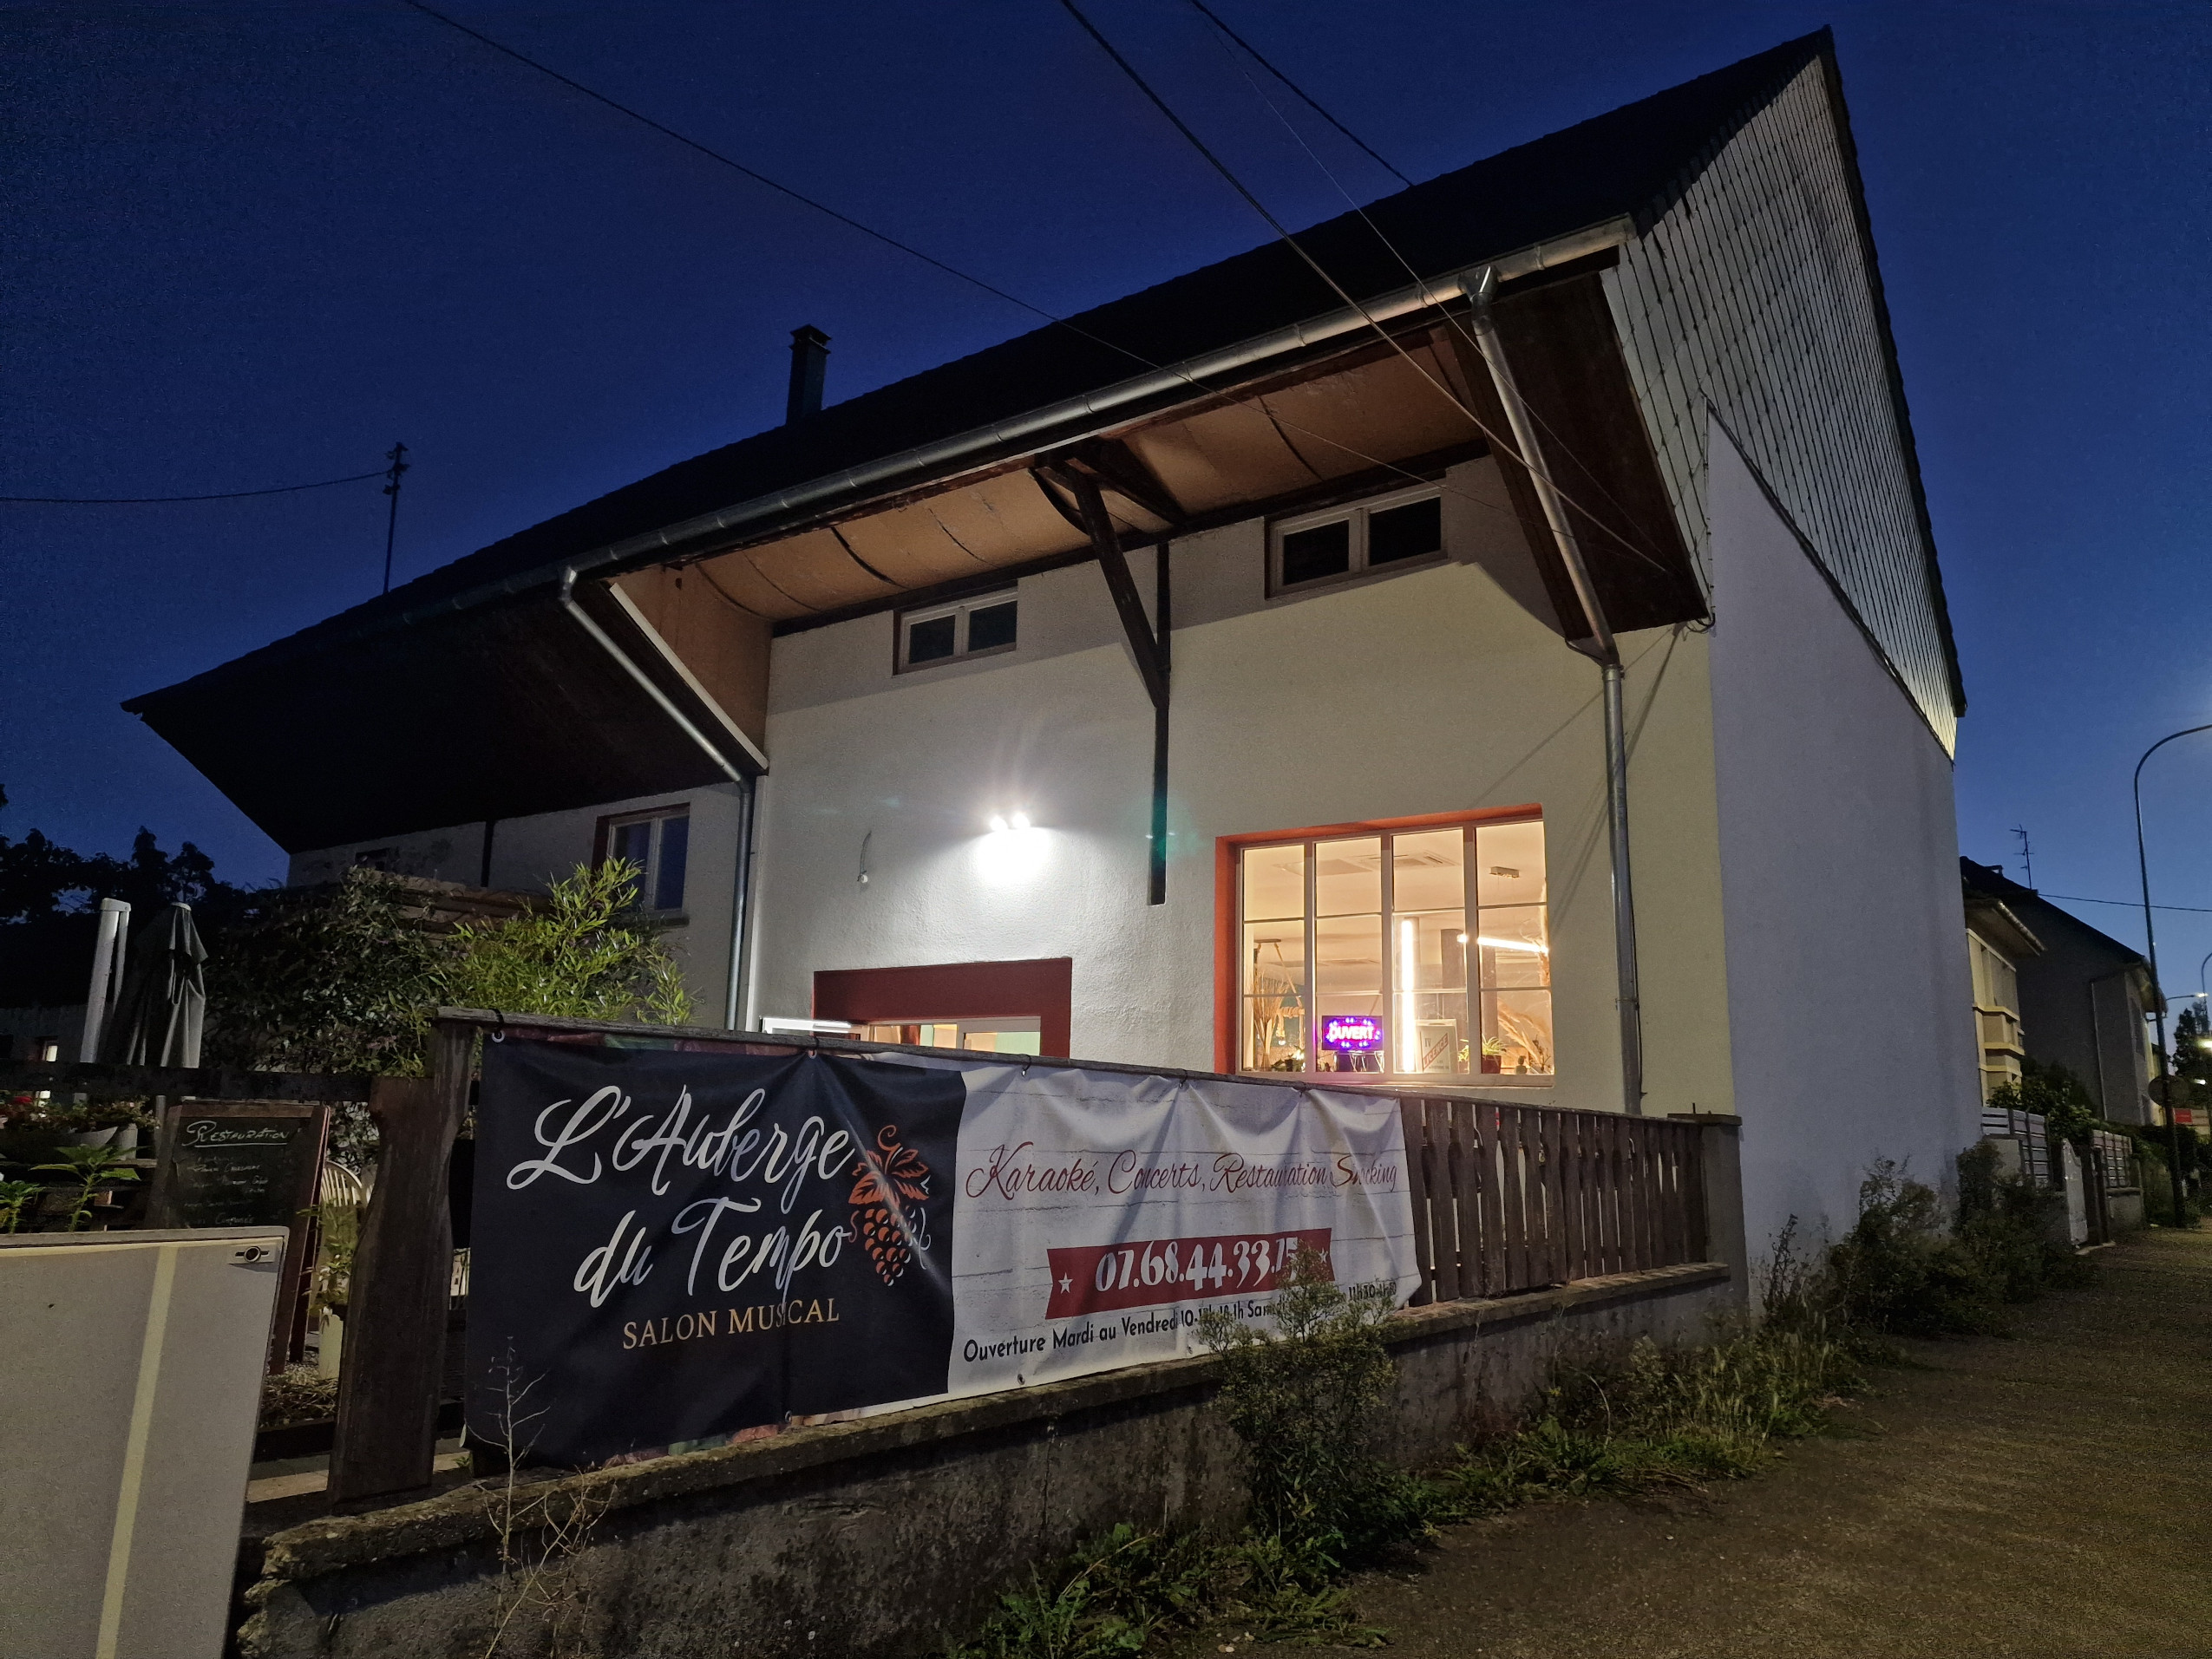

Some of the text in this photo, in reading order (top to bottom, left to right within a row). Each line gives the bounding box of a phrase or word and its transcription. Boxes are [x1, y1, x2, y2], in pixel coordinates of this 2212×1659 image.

[1329, 1025, 1374, 1041] OUVERT
[1423, 1035, 1449, 1068] LICENCE
[507, 1084, 855, 1213] L'Auberge
[965, 1141, 1100, 1200] Karaoké,
[1108, 1149, 1206, 1194] Concerts,
[1209, 1153, 1327, 1193] Restauration
[573, 1197, 852, 1311] du Tempo
[623, 1298, 840, 1349] SALON MUSICAL
[964, 1336, 1046, 1362] Ouverture
[1052, 1322, 1094, 1349] Mardi
[1099, 1326, 1116, 1341] au
[1122, 1311, 1178, 1336] Vendredi
